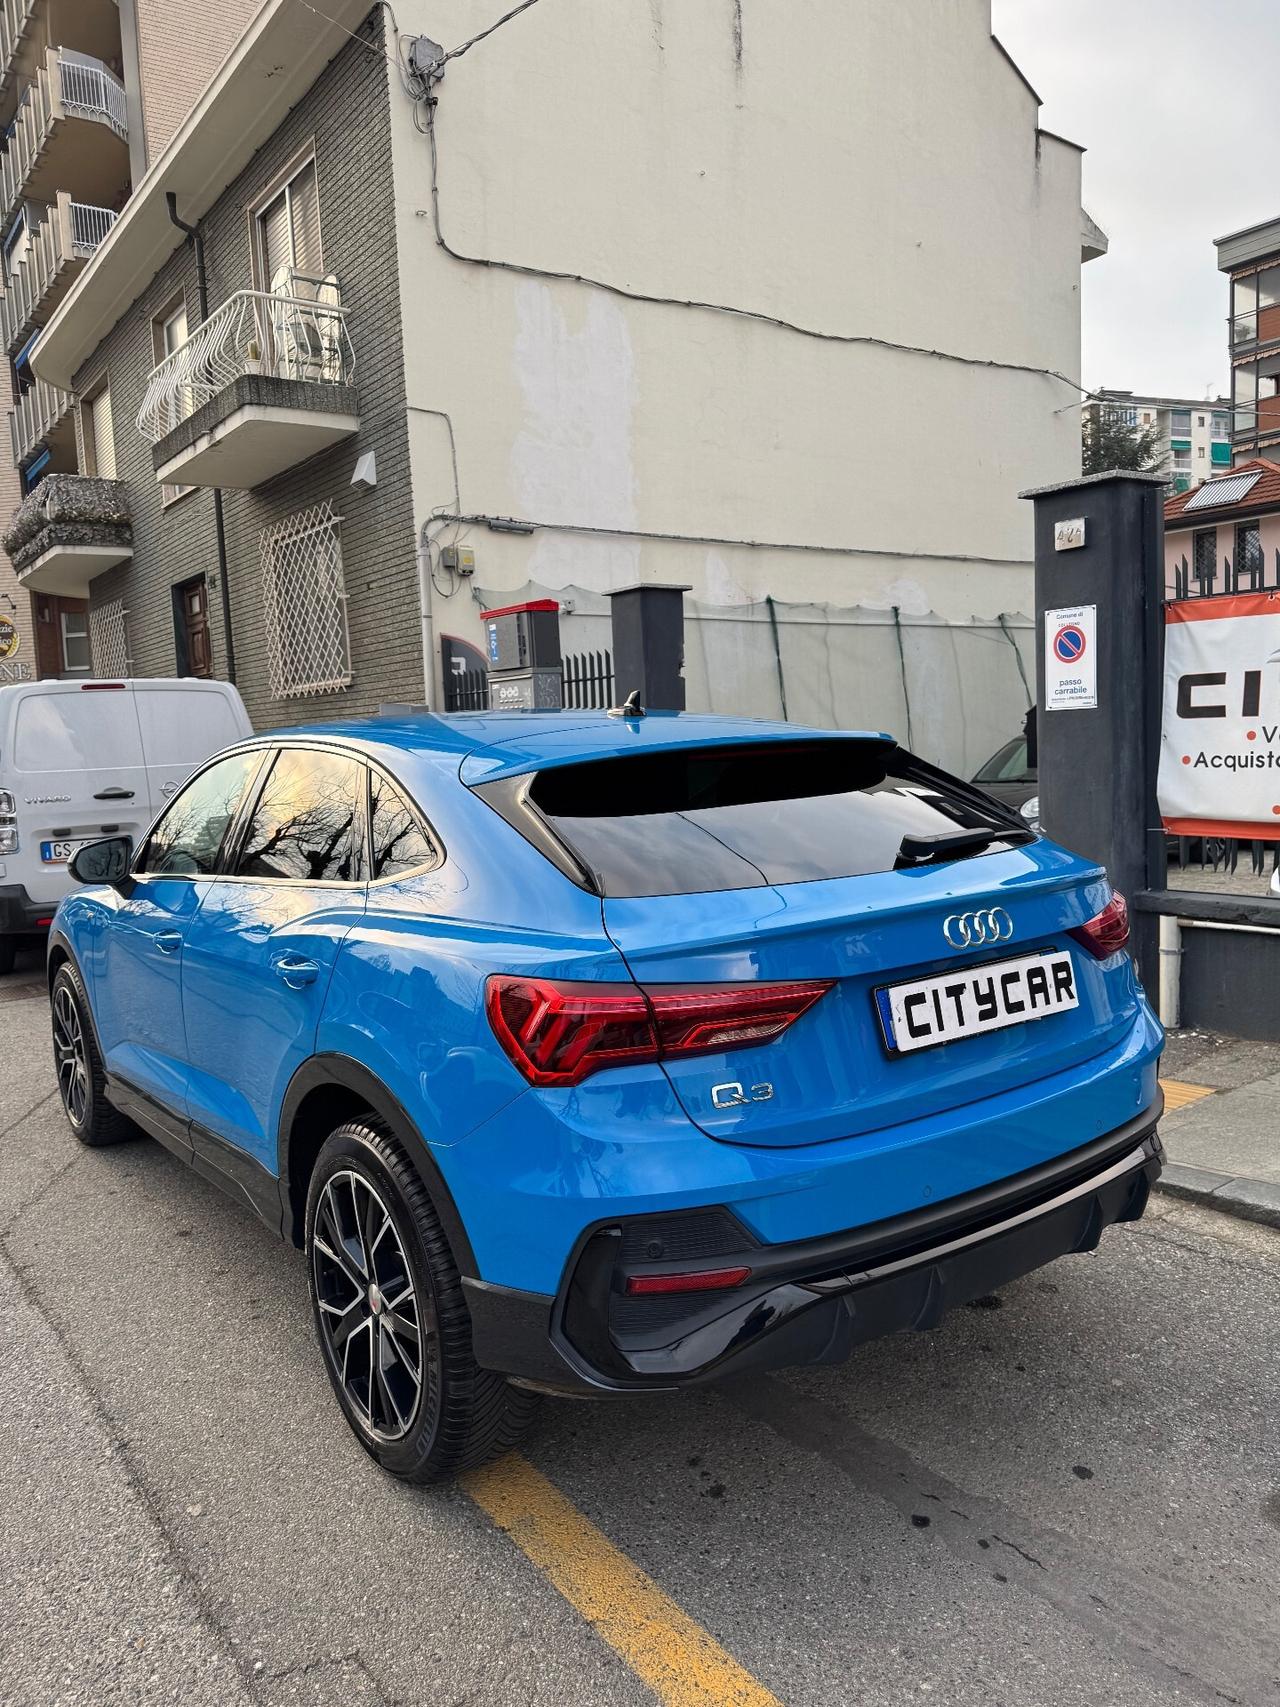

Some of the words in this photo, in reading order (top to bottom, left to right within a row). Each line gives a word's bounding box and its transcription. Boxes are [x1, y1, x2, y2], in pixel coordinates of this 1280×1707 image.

[1054, 686, 1088, 695] carrabile
[1060, 679, 1082, 687] passo
[904, 961, 1075, 1038] CITYCAR
[711, 1082, 773, 1109] Q3
